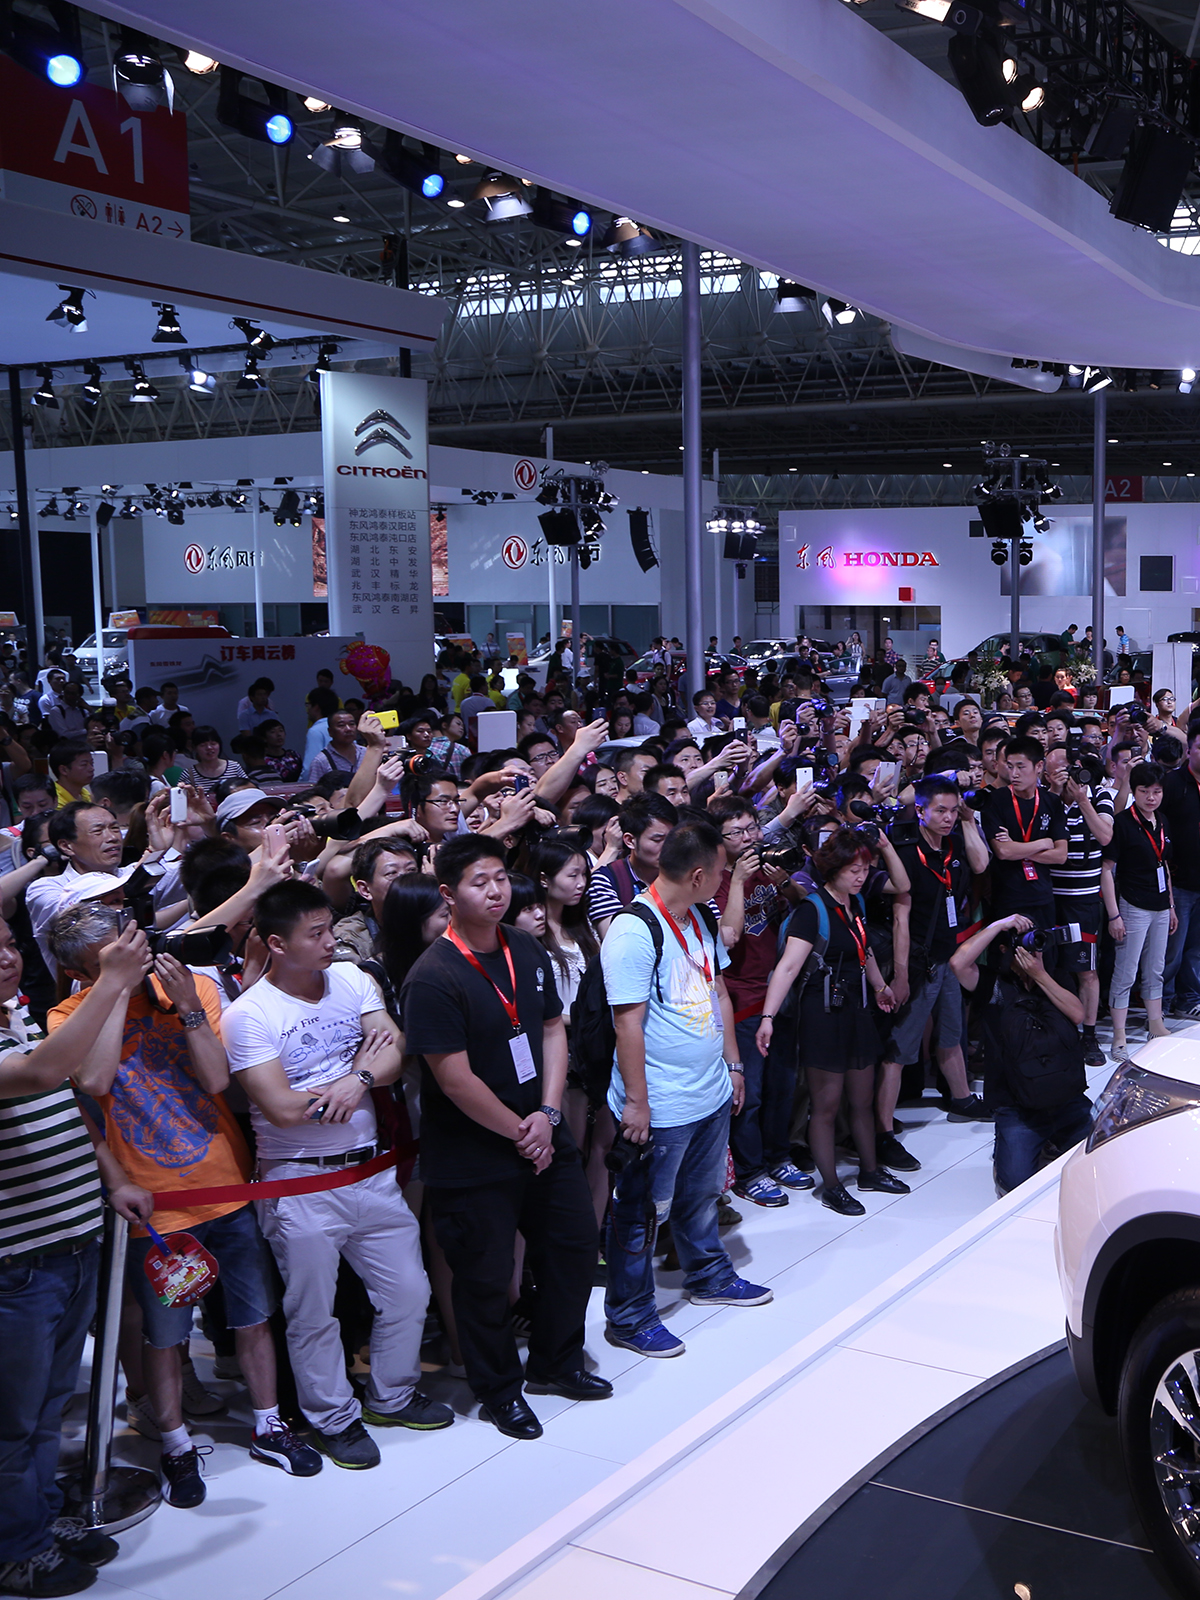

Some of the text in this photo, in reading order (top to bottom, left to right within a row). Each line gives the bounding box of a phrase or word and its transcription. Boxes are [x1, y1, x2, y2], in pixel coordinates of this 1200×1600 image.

[53, 98, 145, 185] A1
[135, 212, 163, 236] A2
[1104, 479, 1131, 498] A2
[349, 520, 417, 532] 东风鸿泰汉阳店
[350, 545, 418, 556] 湖北东安
[350, 557, 418, 568] 湖北中发
[843, 552, 940, 567] HONDA
[351, 569, 419, 579] 武汉精华
[220, 644, 296, 662] 订车风云榜
[280, 1016, 320, 1040] Spit Fire
